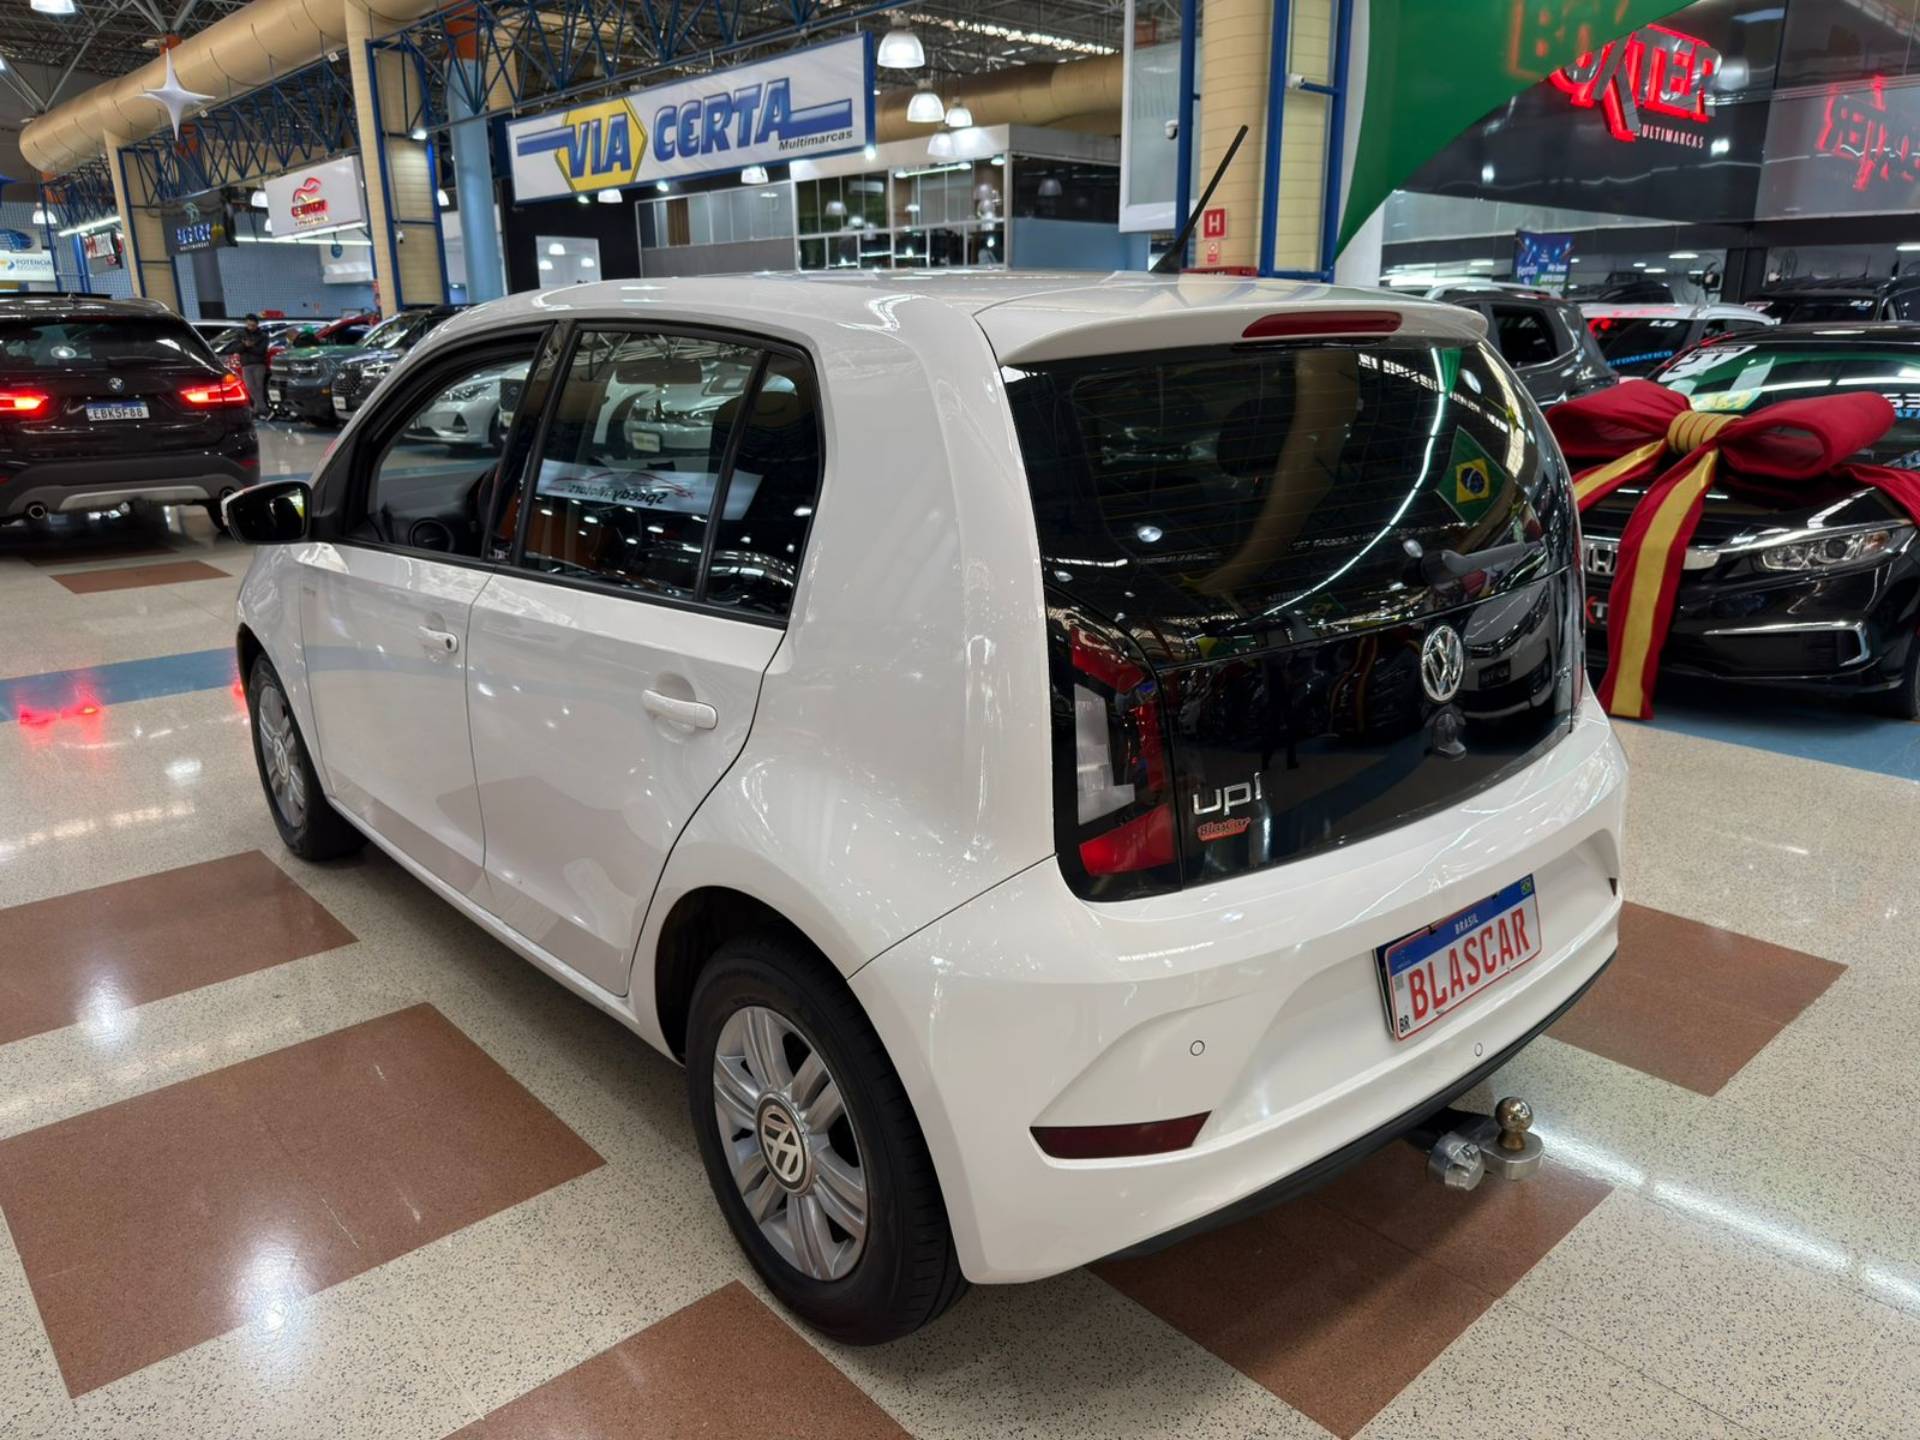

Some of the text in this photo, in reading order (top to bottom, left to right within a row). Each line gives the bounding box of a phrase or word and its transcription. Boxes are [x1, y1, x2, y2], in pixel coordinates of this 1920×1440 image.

[569, 77, 792, 178] VIA CERTA
[779, 130, 853, 152] Multimarcas
[1208, 213, 1221, 233] H
[1607, 350, 1673, 367] UTOMATICO
[1454, 912, 1479, 935] BRASIL
[1407, 907, 1531, 1021] BLASCAR
[1398, 1014, 1412, 1033] BR
